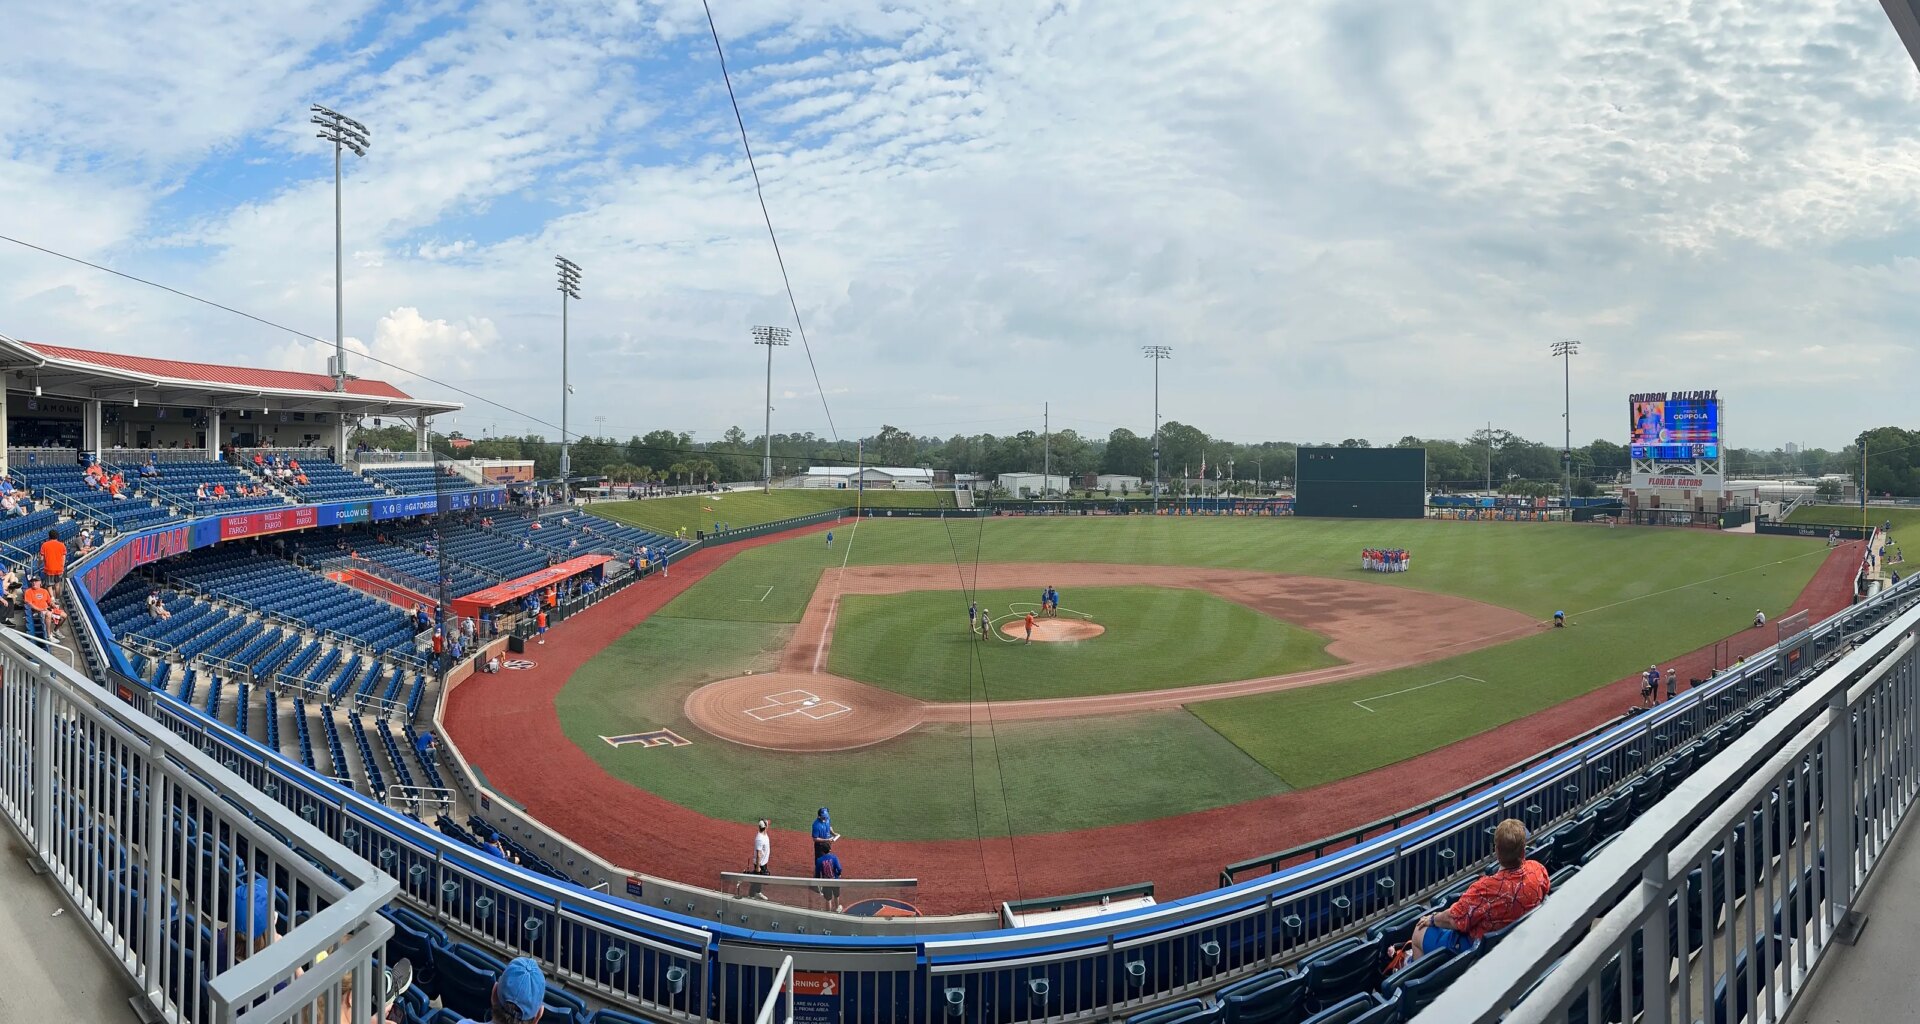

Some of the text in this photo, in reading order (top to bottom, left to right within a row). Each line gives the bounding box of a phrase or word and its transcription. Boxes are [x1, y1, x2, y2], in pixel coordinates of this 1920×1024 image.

[1629, 390, 1718, 402] CONDRON BALLPARK
[1648, 478, 1703, 486] FLORIDA GATORS
[264, 512, 282, 521] WELLS
[295, 508, 312, 518] WELLS
[335, 509, 358, 519] FOLLOW
[228, 516, 248, 526] WELLS
[264, 520, 282, 530] FARGO
[296, 517, 312, 526] FARGO
[228, 526, 248, 535] FARGO
[782, 980, 820, 988] RNING
